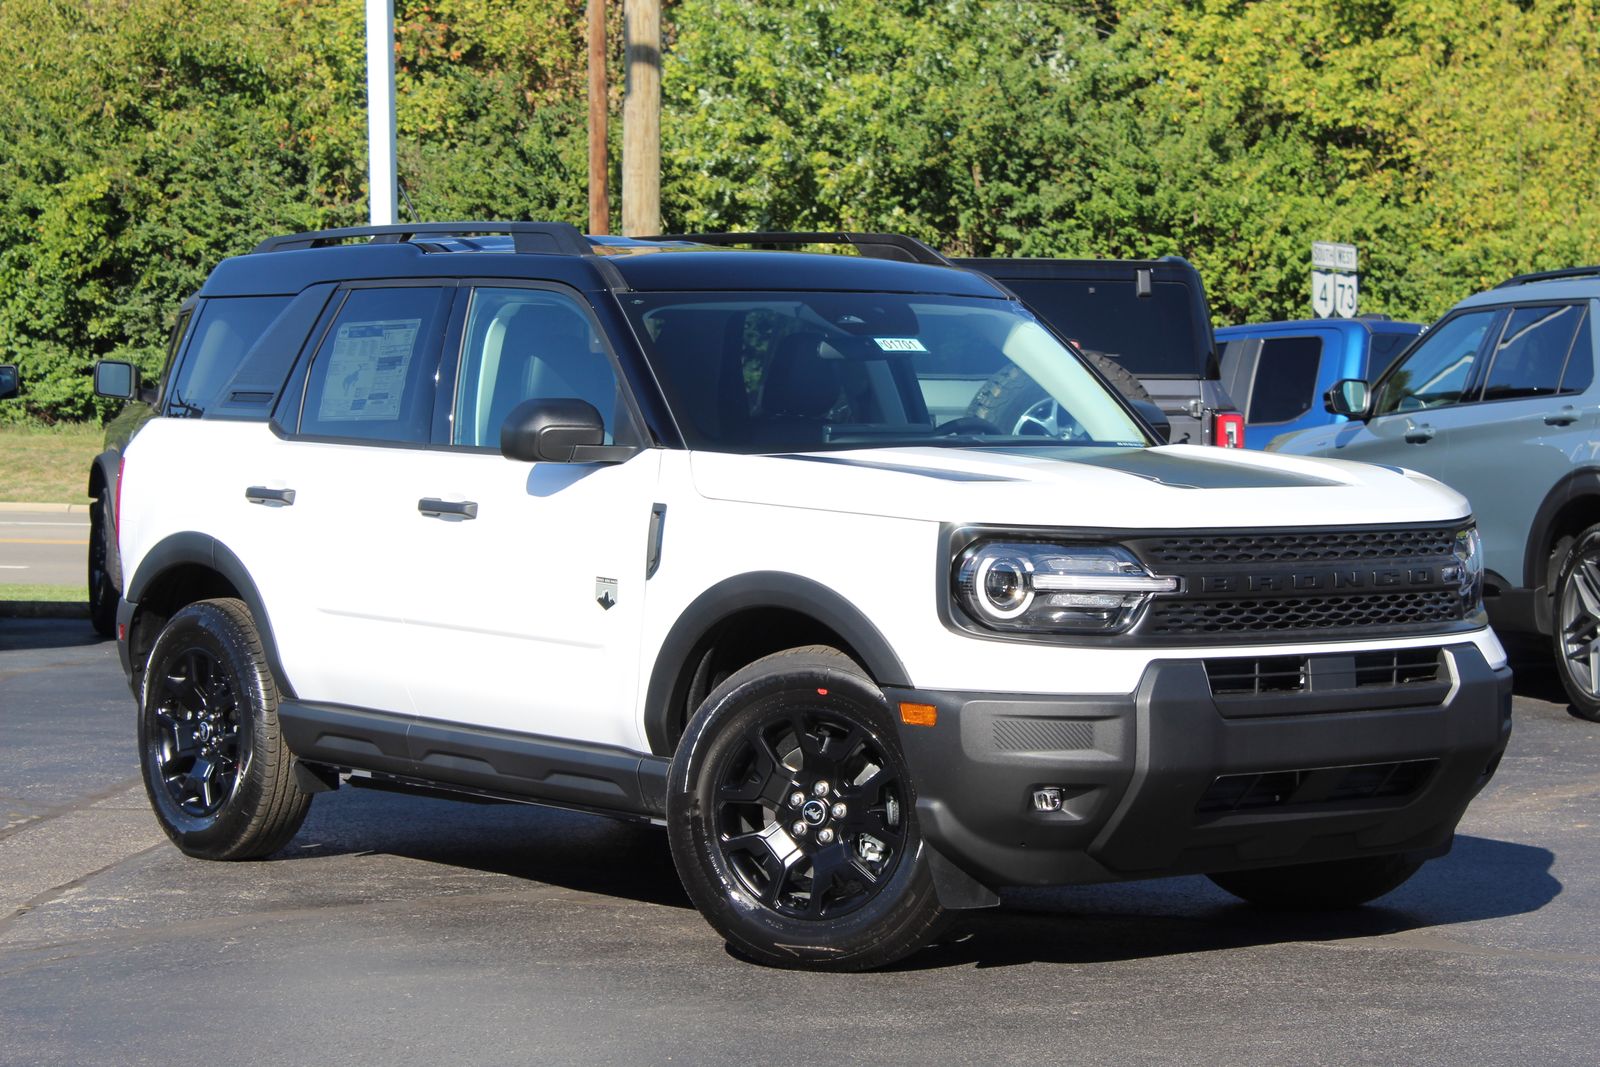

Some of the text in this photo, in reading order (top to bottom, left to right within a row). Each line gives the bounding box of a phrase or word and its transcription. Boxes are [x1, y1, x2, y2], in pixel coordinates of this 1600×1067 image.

[1319, 282, 1328, 308] 4
[1337, 283, 1355, 309] 73
[1202, 567, 1435, 592] BRONCO
